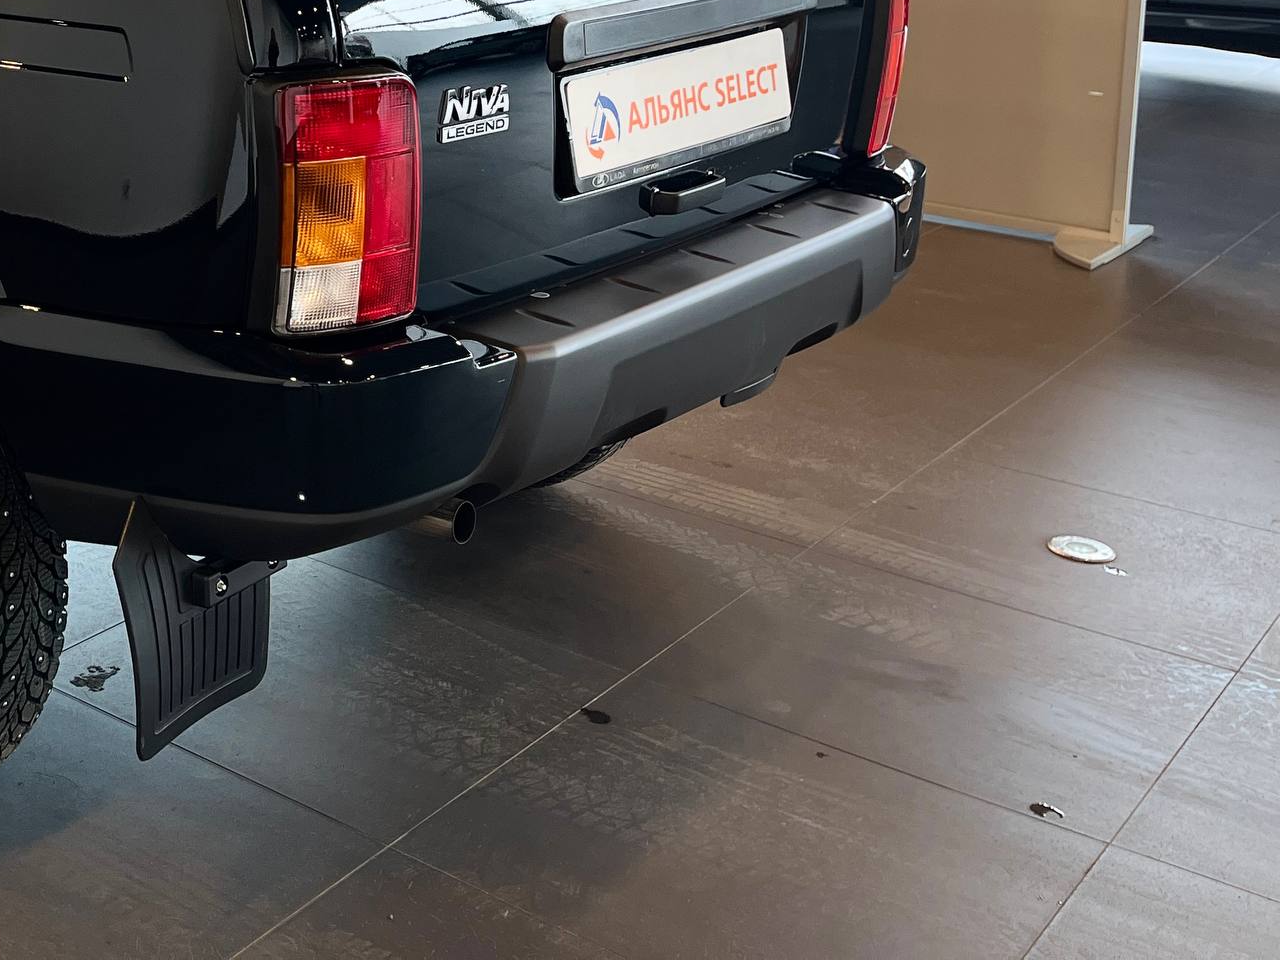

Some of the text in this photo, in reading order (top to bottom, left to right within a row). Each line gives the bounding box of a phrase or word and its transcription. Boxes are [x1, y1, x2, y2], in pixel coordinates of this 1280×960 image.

[440, 83, 509, 125] NIVA
[628, 63, 779, 134] АЛЬЯНС SELECT
[446, 118, 506, 140] LEGEND
